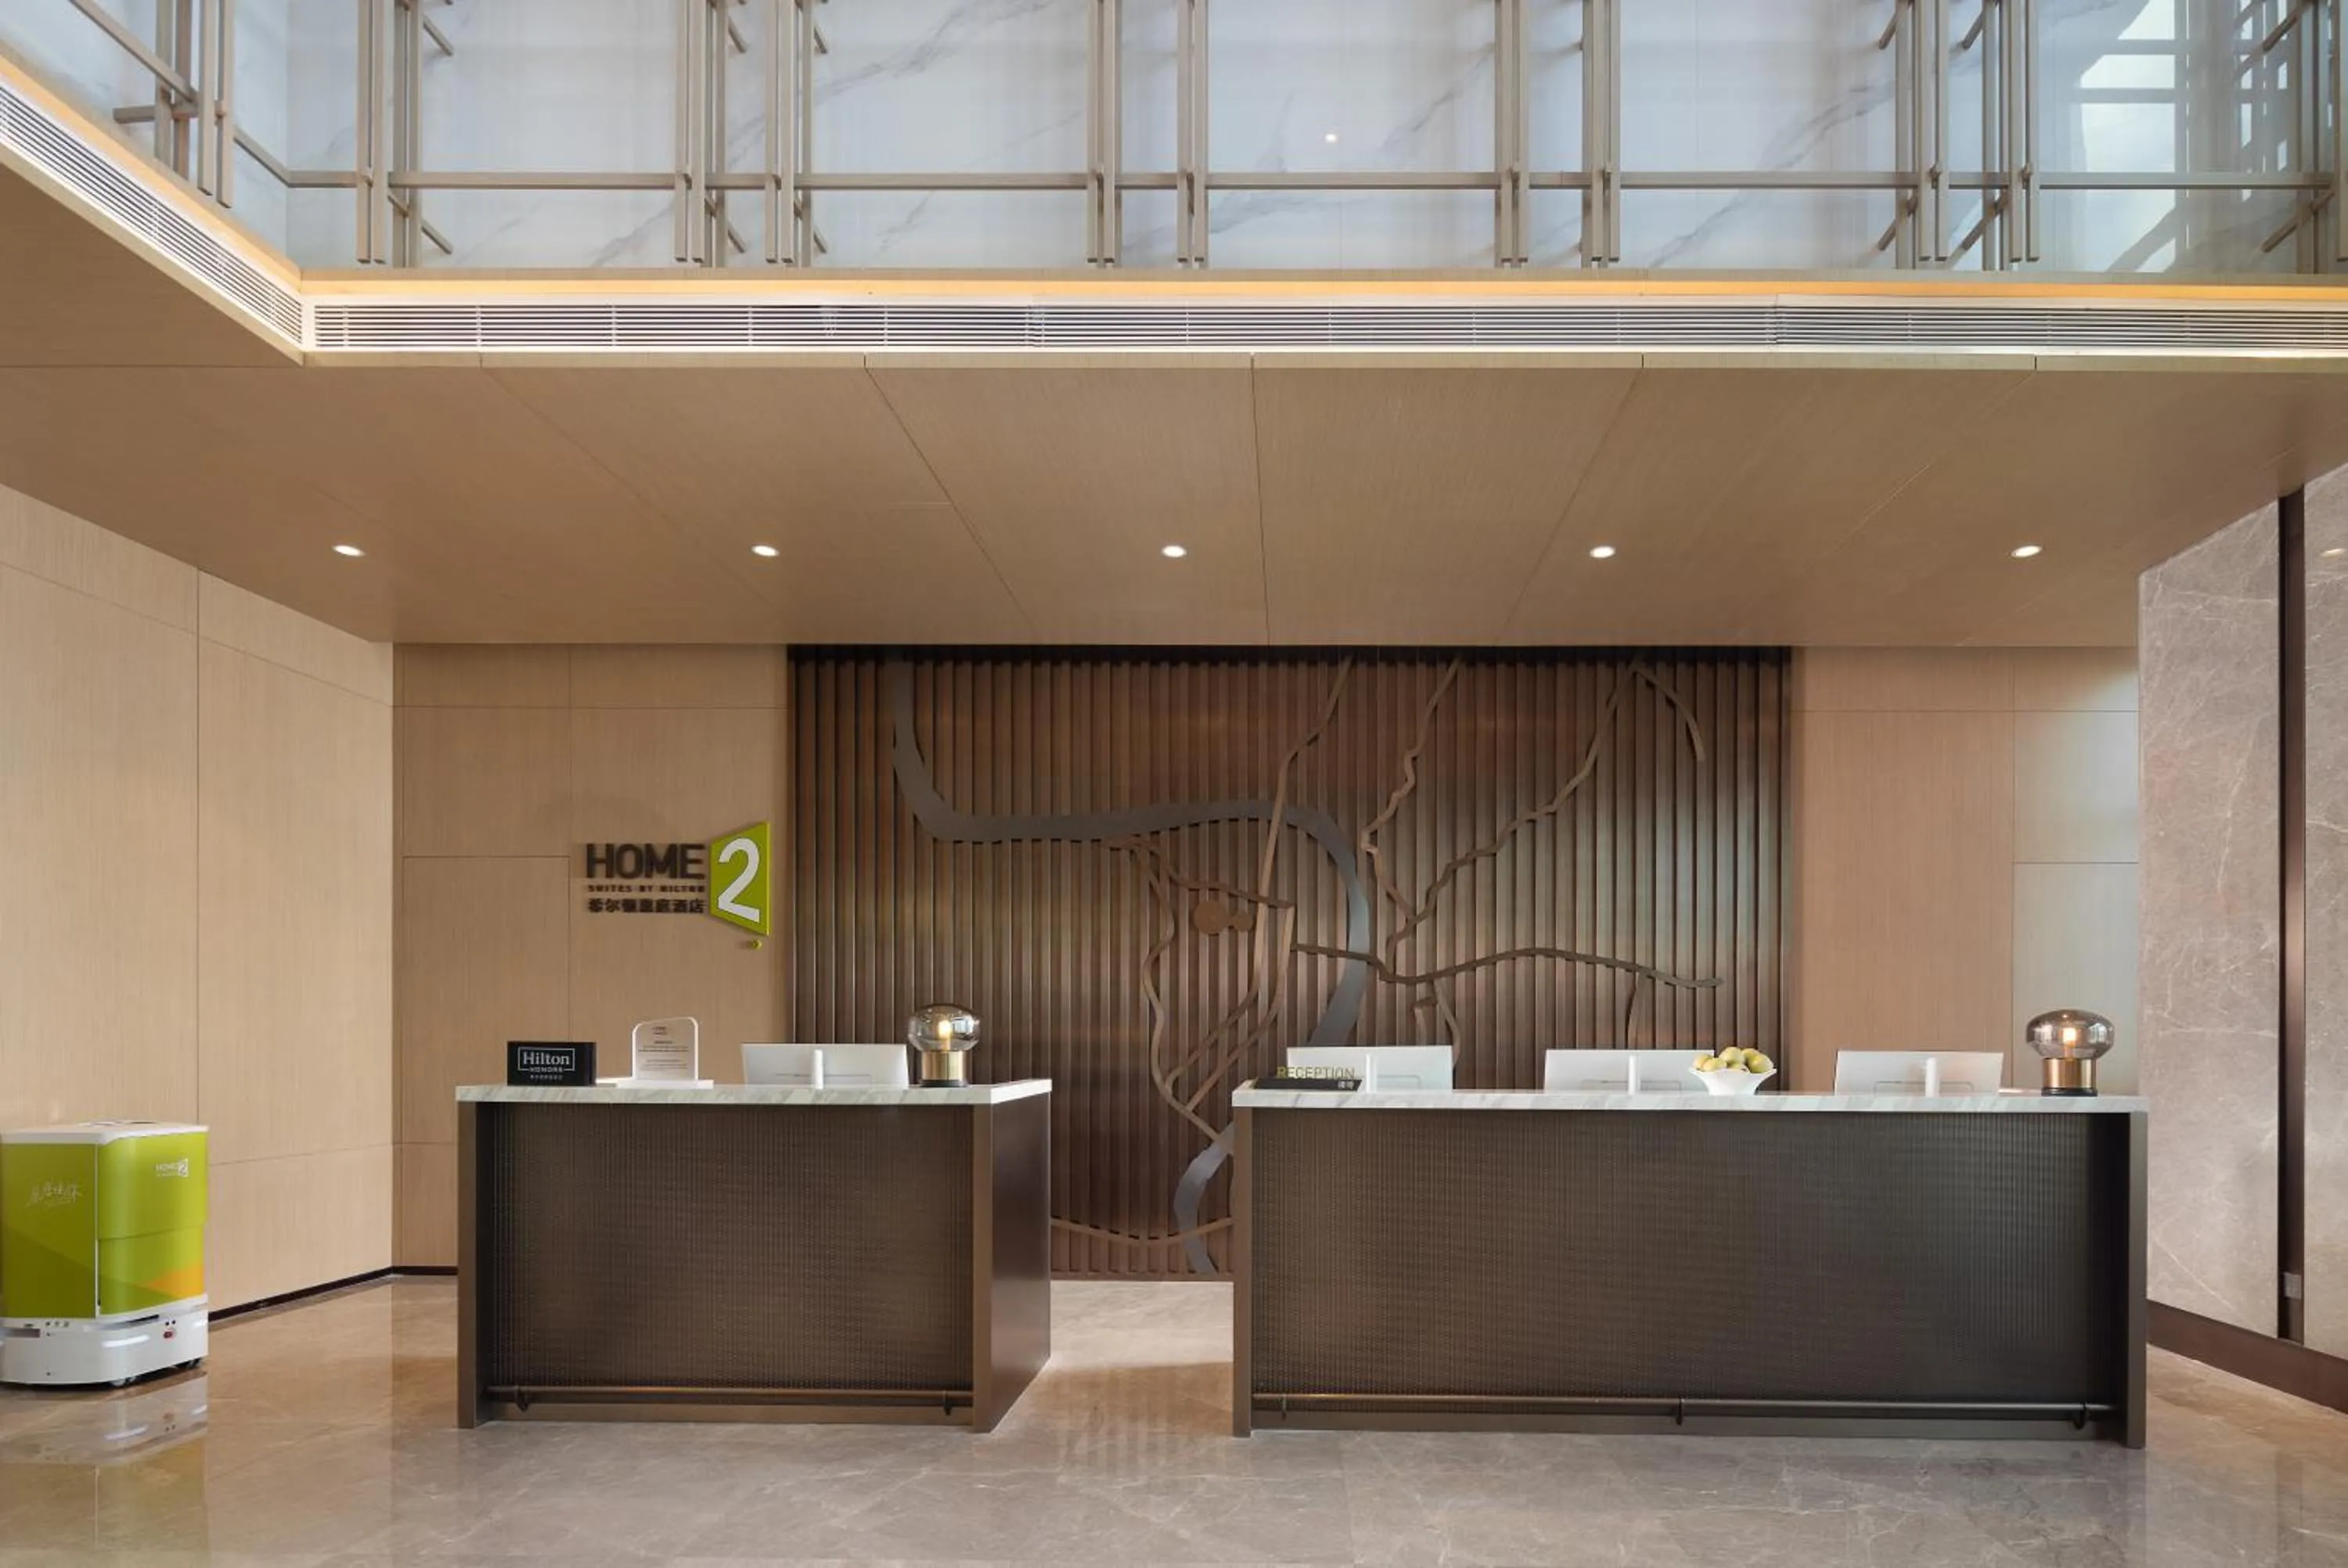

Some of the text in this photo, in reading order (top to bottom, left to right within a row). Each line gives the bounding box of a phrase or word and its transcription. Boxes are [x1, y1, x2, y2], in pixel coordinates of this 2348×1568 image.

[585, 838, 760, 923] HOME 2
[639, 884, 653, 893] BY
[523, 1052, 570, 1065] Hilton
[1277, 1066, 1355, 1080] RECEPTION
